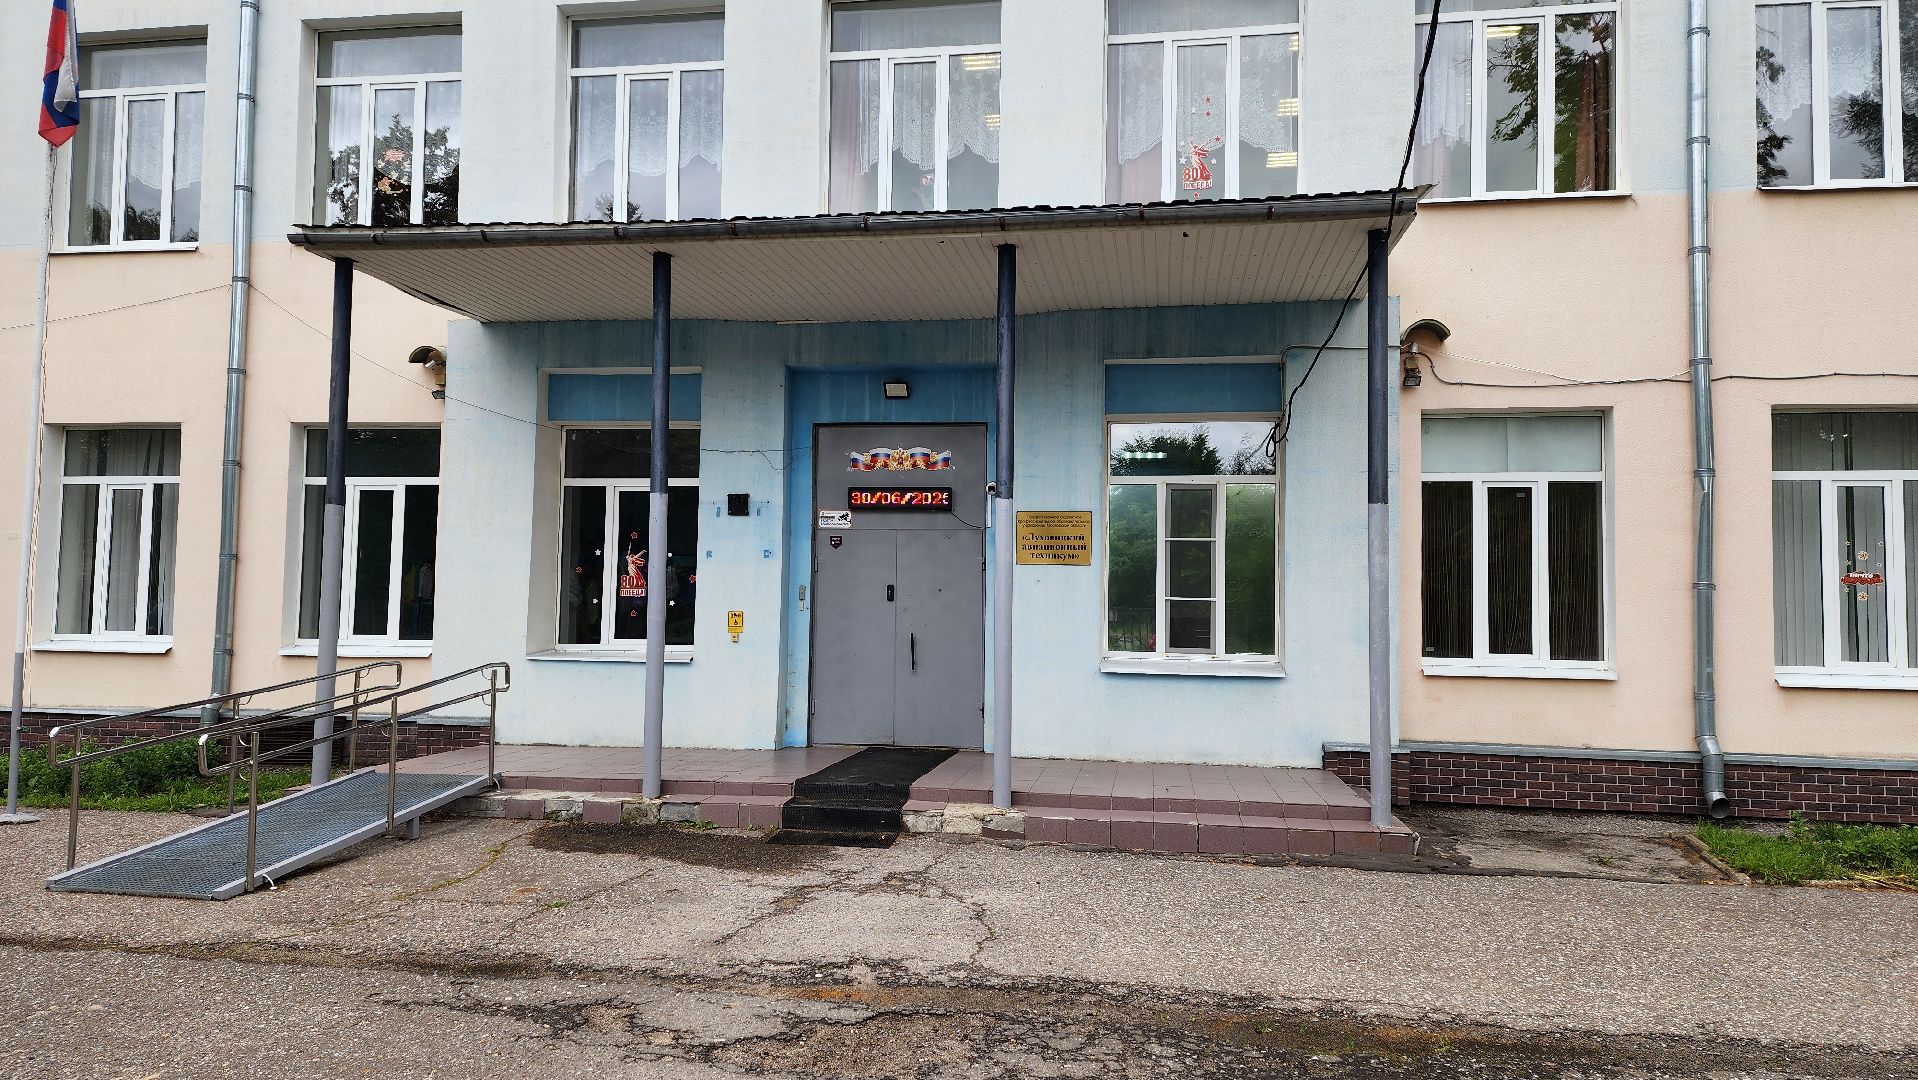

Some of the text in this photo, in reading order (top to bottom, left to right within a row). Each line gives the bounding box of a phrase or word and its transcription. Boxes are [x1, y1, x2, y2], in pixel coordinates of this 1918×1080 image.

[1183, 167, 1199, 180] 80
[1022, 533, 1085, 543] «Луховицкий
[1022, 543, 1087, 551] авиационный
[1030, 552, 1080, 561] техникум»
[620, 575, 636, 588] 80
